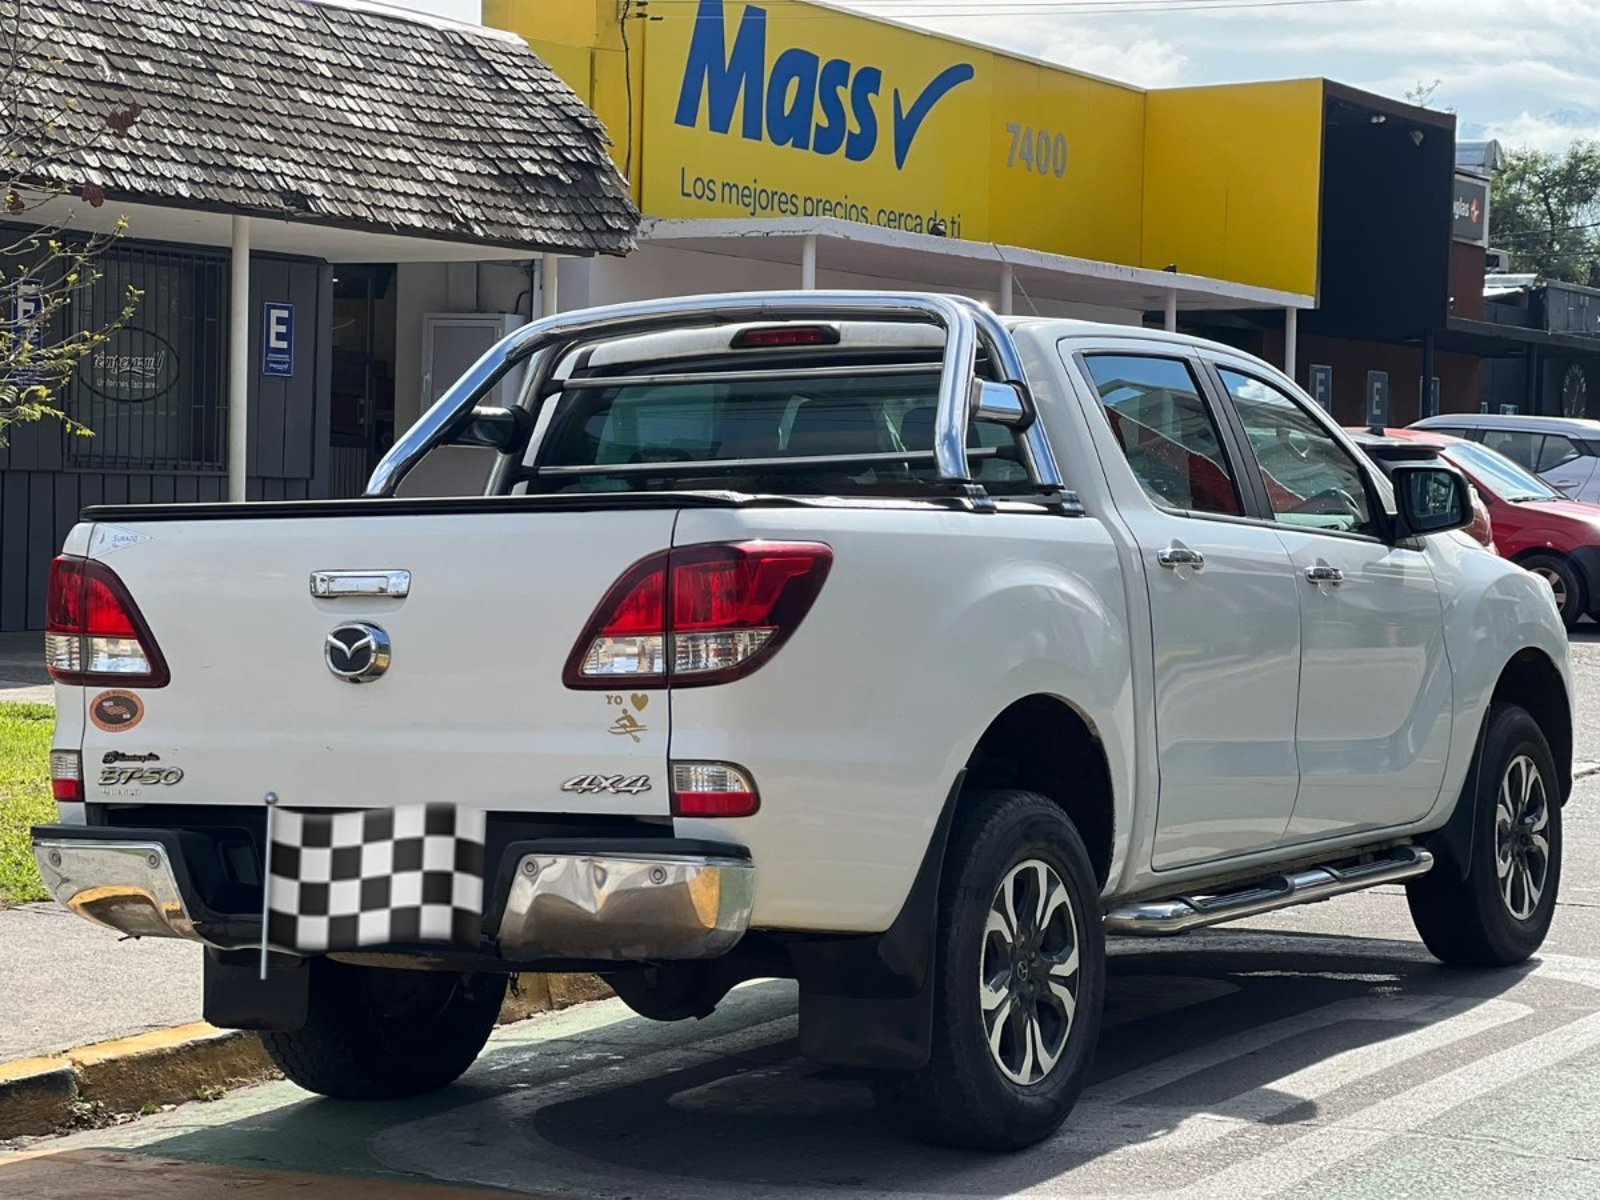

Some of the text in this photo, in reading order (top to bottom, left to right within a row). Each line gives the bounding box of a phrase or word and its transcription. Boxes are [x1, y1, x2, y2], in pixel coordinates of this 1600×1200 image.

[675, 0, 882, 162] Mass
[1006, 122, 1068, 178] 7400
[680, 167, 716, 202] Los
[721, 178, 799, 216] mejores
[876, 207, 923, 234] cerca
[949, 213, 961, 239] ti
[269, 308, 289, 349] E
[1372, 381, 1382, 415] E
[606, 695, 623, 705] YO
[98, 766, 185, 786] BT-50
